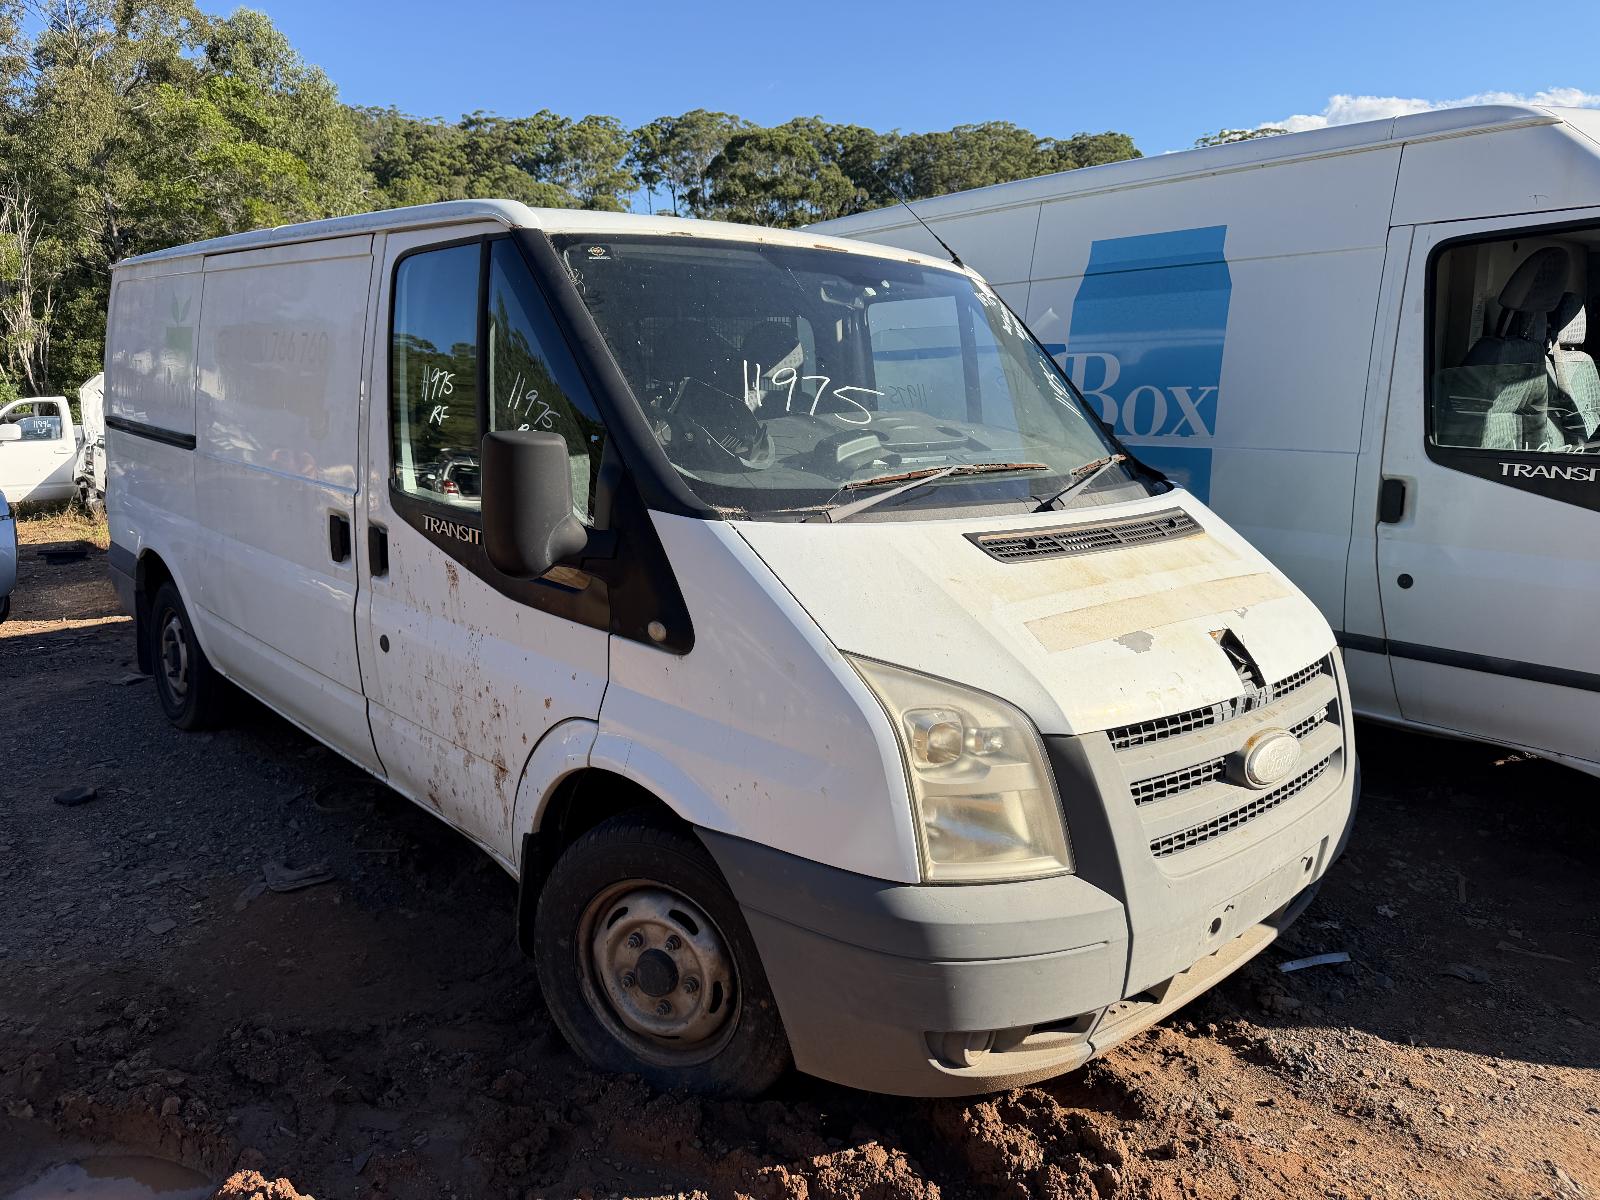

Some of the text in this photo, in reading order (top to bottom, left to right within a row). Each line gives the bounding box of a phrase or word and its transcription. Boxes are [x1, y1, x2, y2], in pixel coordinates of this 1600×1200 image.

[421, 364, 456, 401] 11975
[507, 371, 561, 429] 11975
[743, 359, 885, 425] 11975
[1052, 351, 1219, 438] Box
[429, 405, 451, 426] RF
[422, 514, 482, 545] TRANSIT
